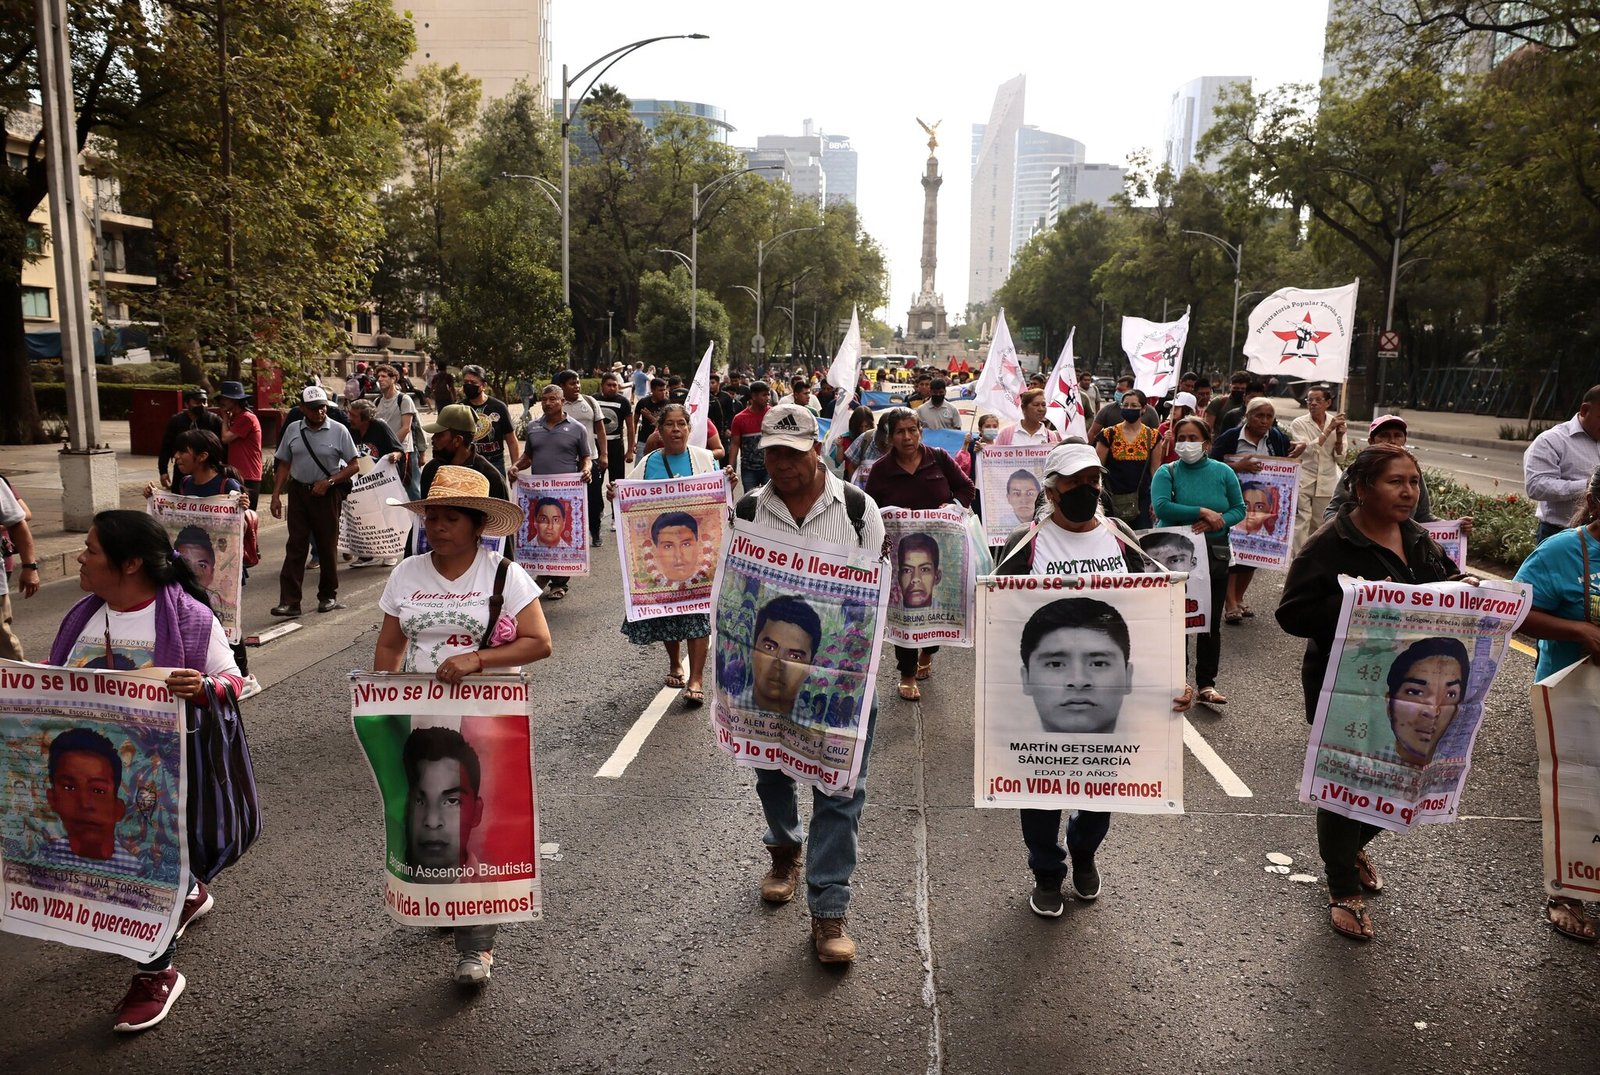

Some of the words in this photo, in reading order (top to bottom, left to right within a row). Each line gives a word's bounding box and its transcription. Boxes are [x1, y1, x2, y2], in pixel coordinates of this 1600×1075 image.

[1291, 300, 1319, 308] Popular
[1015, 449, 1023, 457] lo
[1025, 449, 1051, 457] llevar
[531, 480, 541, 488] se
[621, 486, 647, 500] ¡Vivo
[650, 488, 663, 496] se
[665, 484, 675, 494] lo
[678, 479, 724, 493] llevaron!
[176, 502, 187, 510] se
[189, 503, 197, 511] lo
[199, 503, 239, 514] llevaron!
[896, 511, 908, 519] se
[911, 511, 921, 519] lo
[992, 537, 1008, 545] ¡Viv
[1430, 529, 1459, 540] aron!
[731, 535, 766, 560] ¡Vivo
[767, 550, 788, 566] se
[791, 552, 804, 571] lo
[807, 556, 879, 584] llevaron!
[1046, 555, 1123, 575] AYOTZINAPA
[1238, 552, 1280, 564] queremos!
[546, 564, 583, 572] queremos!
[1042, 577, 1063, 590] se
[1090, 574, 1171, 590] llevaron!
[1356, 584, 1406, 606] ¡Vivo
[1411, 591, 1434, 606] se
[1439, 593, 1455, 608] lo
[1459, 591, 1522, 616] llevaron!
[638, 606, 662, 618] ¡Vivo
[664, 605, 674, 614] lo
[676, 602, 711, 614] querem
[903, 614, 925, 622] BRUNO
[446, 634, 473, 647] 43
[902, 630, 910, 640] lo
[912, 629, 960, 642] queremos!
[1356, 663, 1382, 682] 43
[1, 669, 35, 690] ivo
[41, 675, 64, 691] se
[70, 673, 89, 693] lo
[94, 675, 175, 704] llevaron!
[353, 683, 399, 708] ¡Vivo
[402, 683, 423, 701] se
[427, 680, 444, 701] lo
[450, 682, 530, 701] llevaron!
[731, 725, 746, 734] elso
[743, 718, 765, 729] ALEN
[800, 735, 810, 744] DE
[813, 739, 824, 749] LA
[826, 744, 850, 757] CRUZ
[1344, 721, 1369, 740] 43
[1009, 741, 1058, 753] MARTÍN
[1061, 743, 1141, 754] GETSEMANY
[719, 729, 741, 754] ¡Vio
[745, 741, 760, 757] lo
[765, 746, 839, 786] queremos!
[1018, 754, 1080, 766] SÁNCHEZ
[1082, 755, 1131, 766] GARCÍA
[1034, 769, 1065, 777] EDAD
[1069, 769, 1083, 777] 20
[1086, 769, 1118, 778] AÑOS
[989, 776, 1021, 795] ¡Con
[1026, 777, 1063, 795] VIDA
[1066, 778, 1080, 796] lo
[1084, 781, 1162, 799] queremos!
[1321, 782, 1370, 808] ¡Vivo
[1375, 796, 1395, 815] lo
[415, 863, 475, 879] Ascencio
[479, 861, 534, 877] Bautista
[84, 875, 110, 890] LUNA
[115, 881, 151, 897] TORRES
[425, 896, 440, 917] lo
[445, 891, 535, 921] queremos!
[10, 890, 39, 913] ¡Con
[42, 896, 73, 922] VIDA
[76, 903, 89, 925] lo
[91, 911, 162, 943] queremos!
